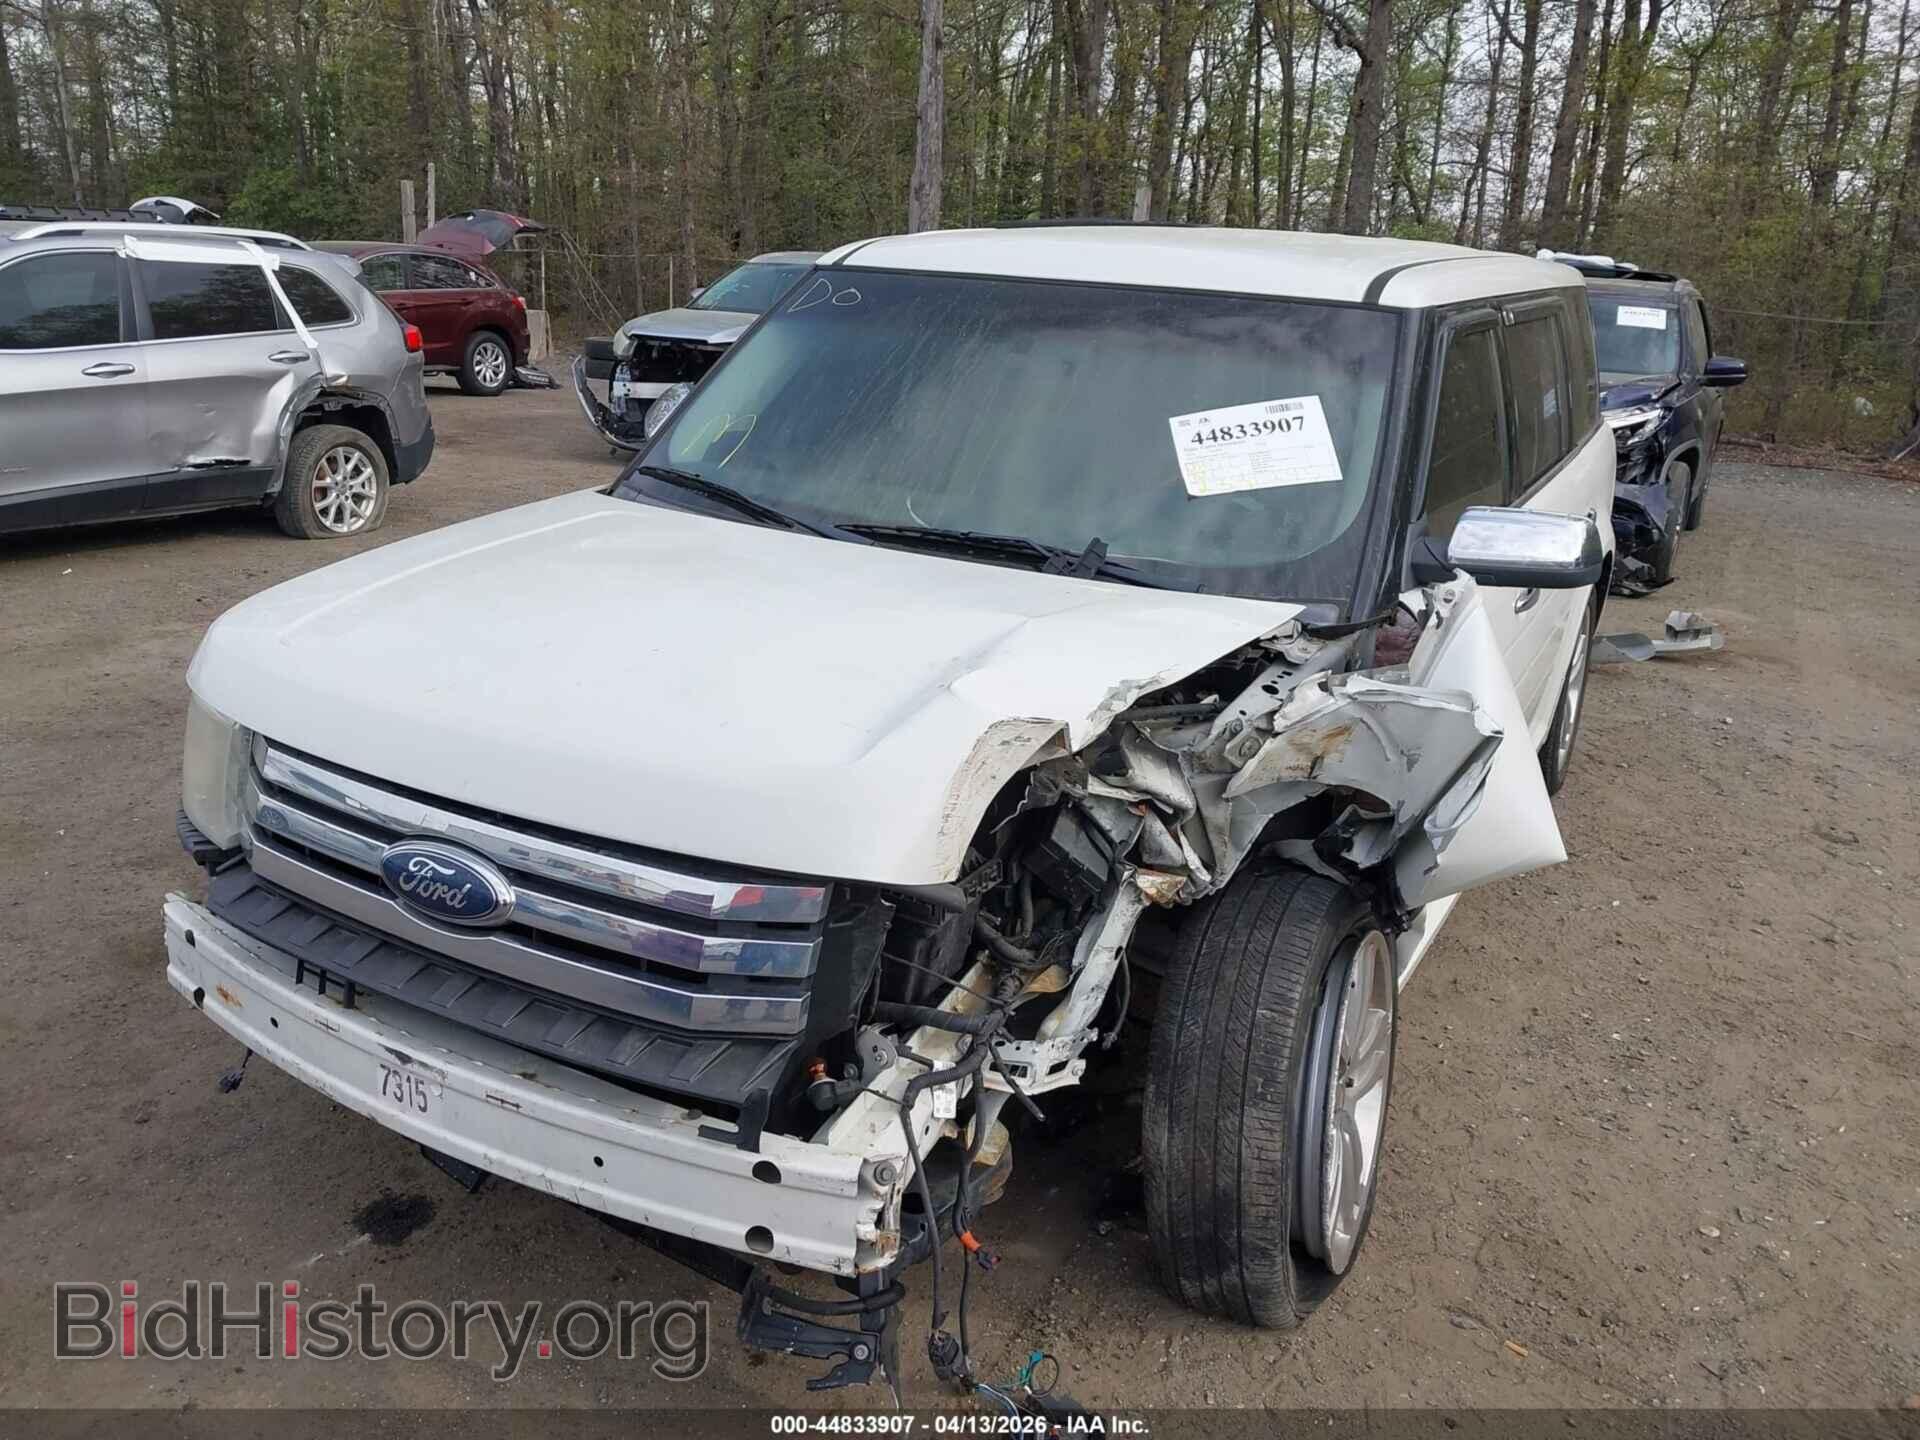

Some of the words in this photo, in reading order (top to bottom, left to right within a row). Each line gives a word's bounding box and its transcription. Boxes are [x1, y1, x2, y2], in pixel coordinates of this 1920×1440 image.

[1191, 415, 1305, 446] 44833907
[399, 856, 473, 909] Ford
[380, 1063, 429, 1114] 7315
